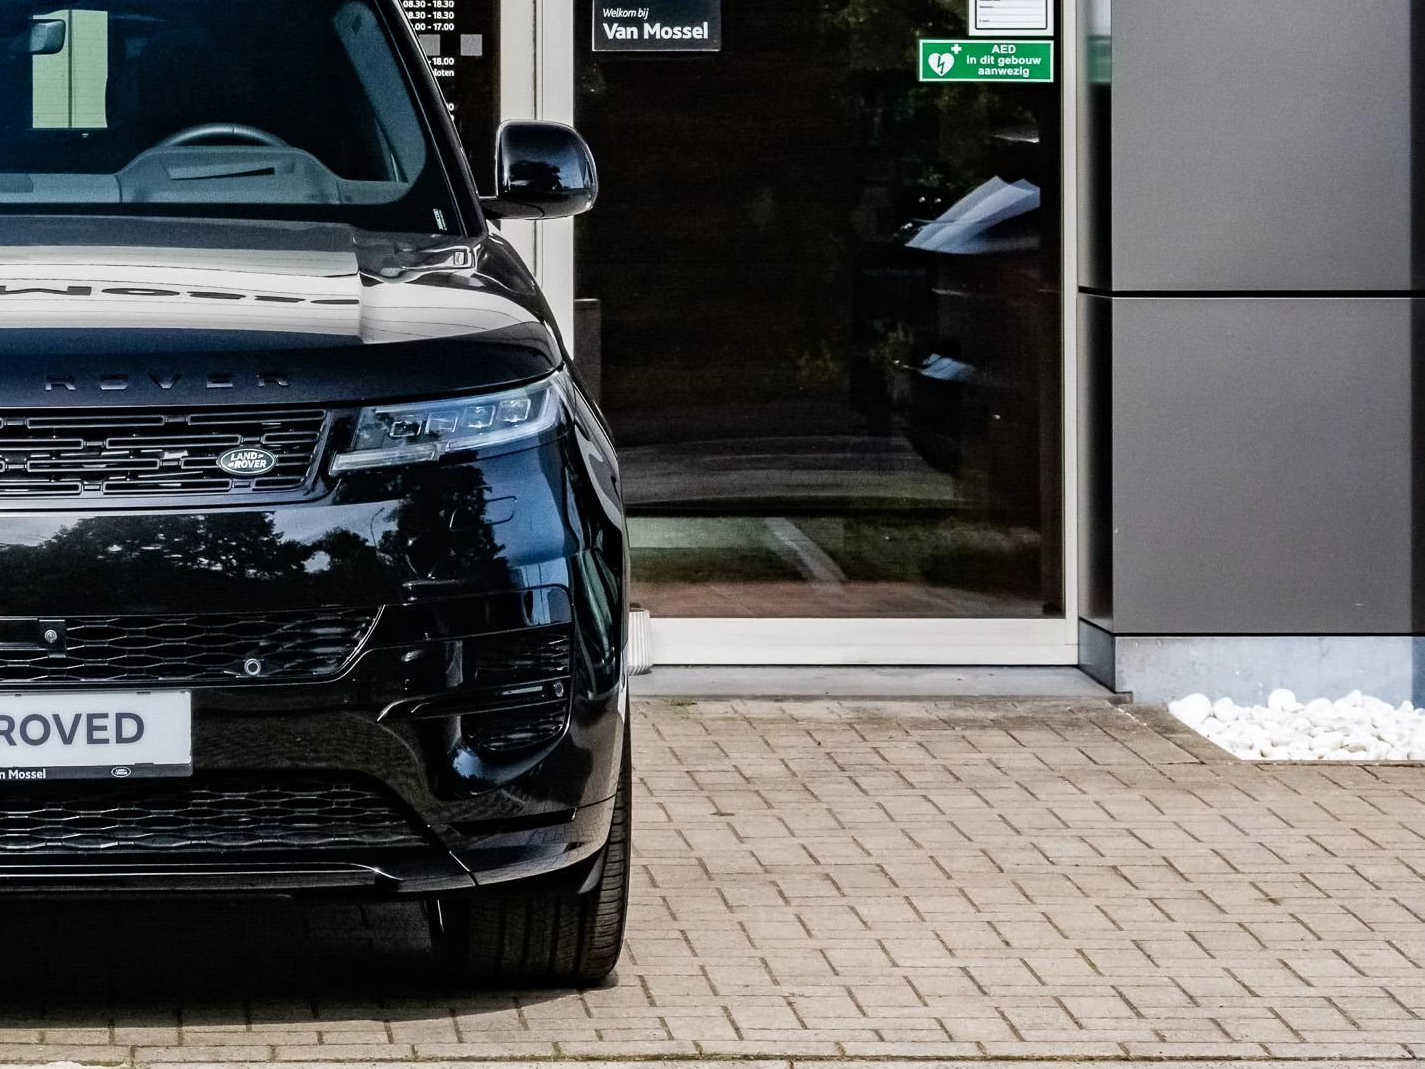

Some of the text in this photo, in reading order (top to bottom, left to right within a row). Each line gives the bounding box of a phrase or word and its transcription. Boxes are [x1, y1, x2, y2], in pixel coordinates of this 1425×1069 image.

[402, 0, 426, 8] 08.30
[432, 0, 455, 8] 18.30
[432, 11, 455, 19] 18.30
[603, 8, 650, 20] Welkom bij
[432, 23, 455, 31] 17.00
[603, 22, 708, 40] Van Mossel
[991, 44, 1016, 54] AED
[432, 58, 455, 66] 18.00
[980, 55, 995, 65] dit
[998, 55, 1042, 67] gebouw
[978, 66, 1030, 78] aanwezig
[44, 371, 289, 391] ROVER
[230, 451, 258, 461] LAND
[234, 459, 267, 469] ROVER
[8, 768, 47, 779] Mossel
